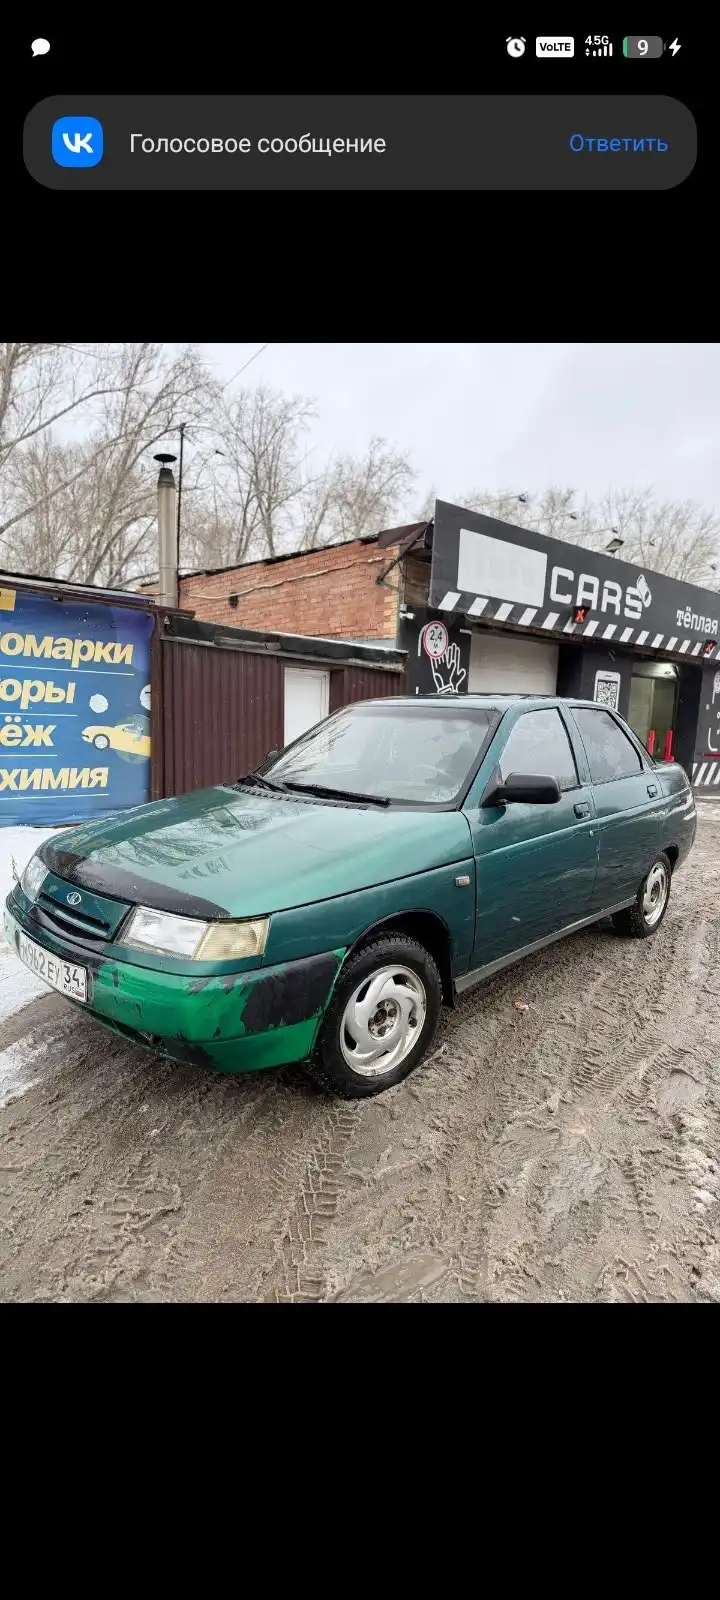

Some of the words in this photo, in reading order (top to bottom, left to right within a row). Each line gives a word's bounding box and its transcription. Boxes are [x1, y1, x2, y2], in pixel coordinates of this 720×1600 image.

[549, 566, 645, 620] CARS
[429, 629, 443, 642] 2,4
[676, 605, 719, 635] тёплая
[0, 631, 134, 668] омарки
[0, 678, 76, 710] оры
[0, 715, 57, 747] ёж
[0, 767, 109, 791] химия
[63, 964, 80, 988] 34
